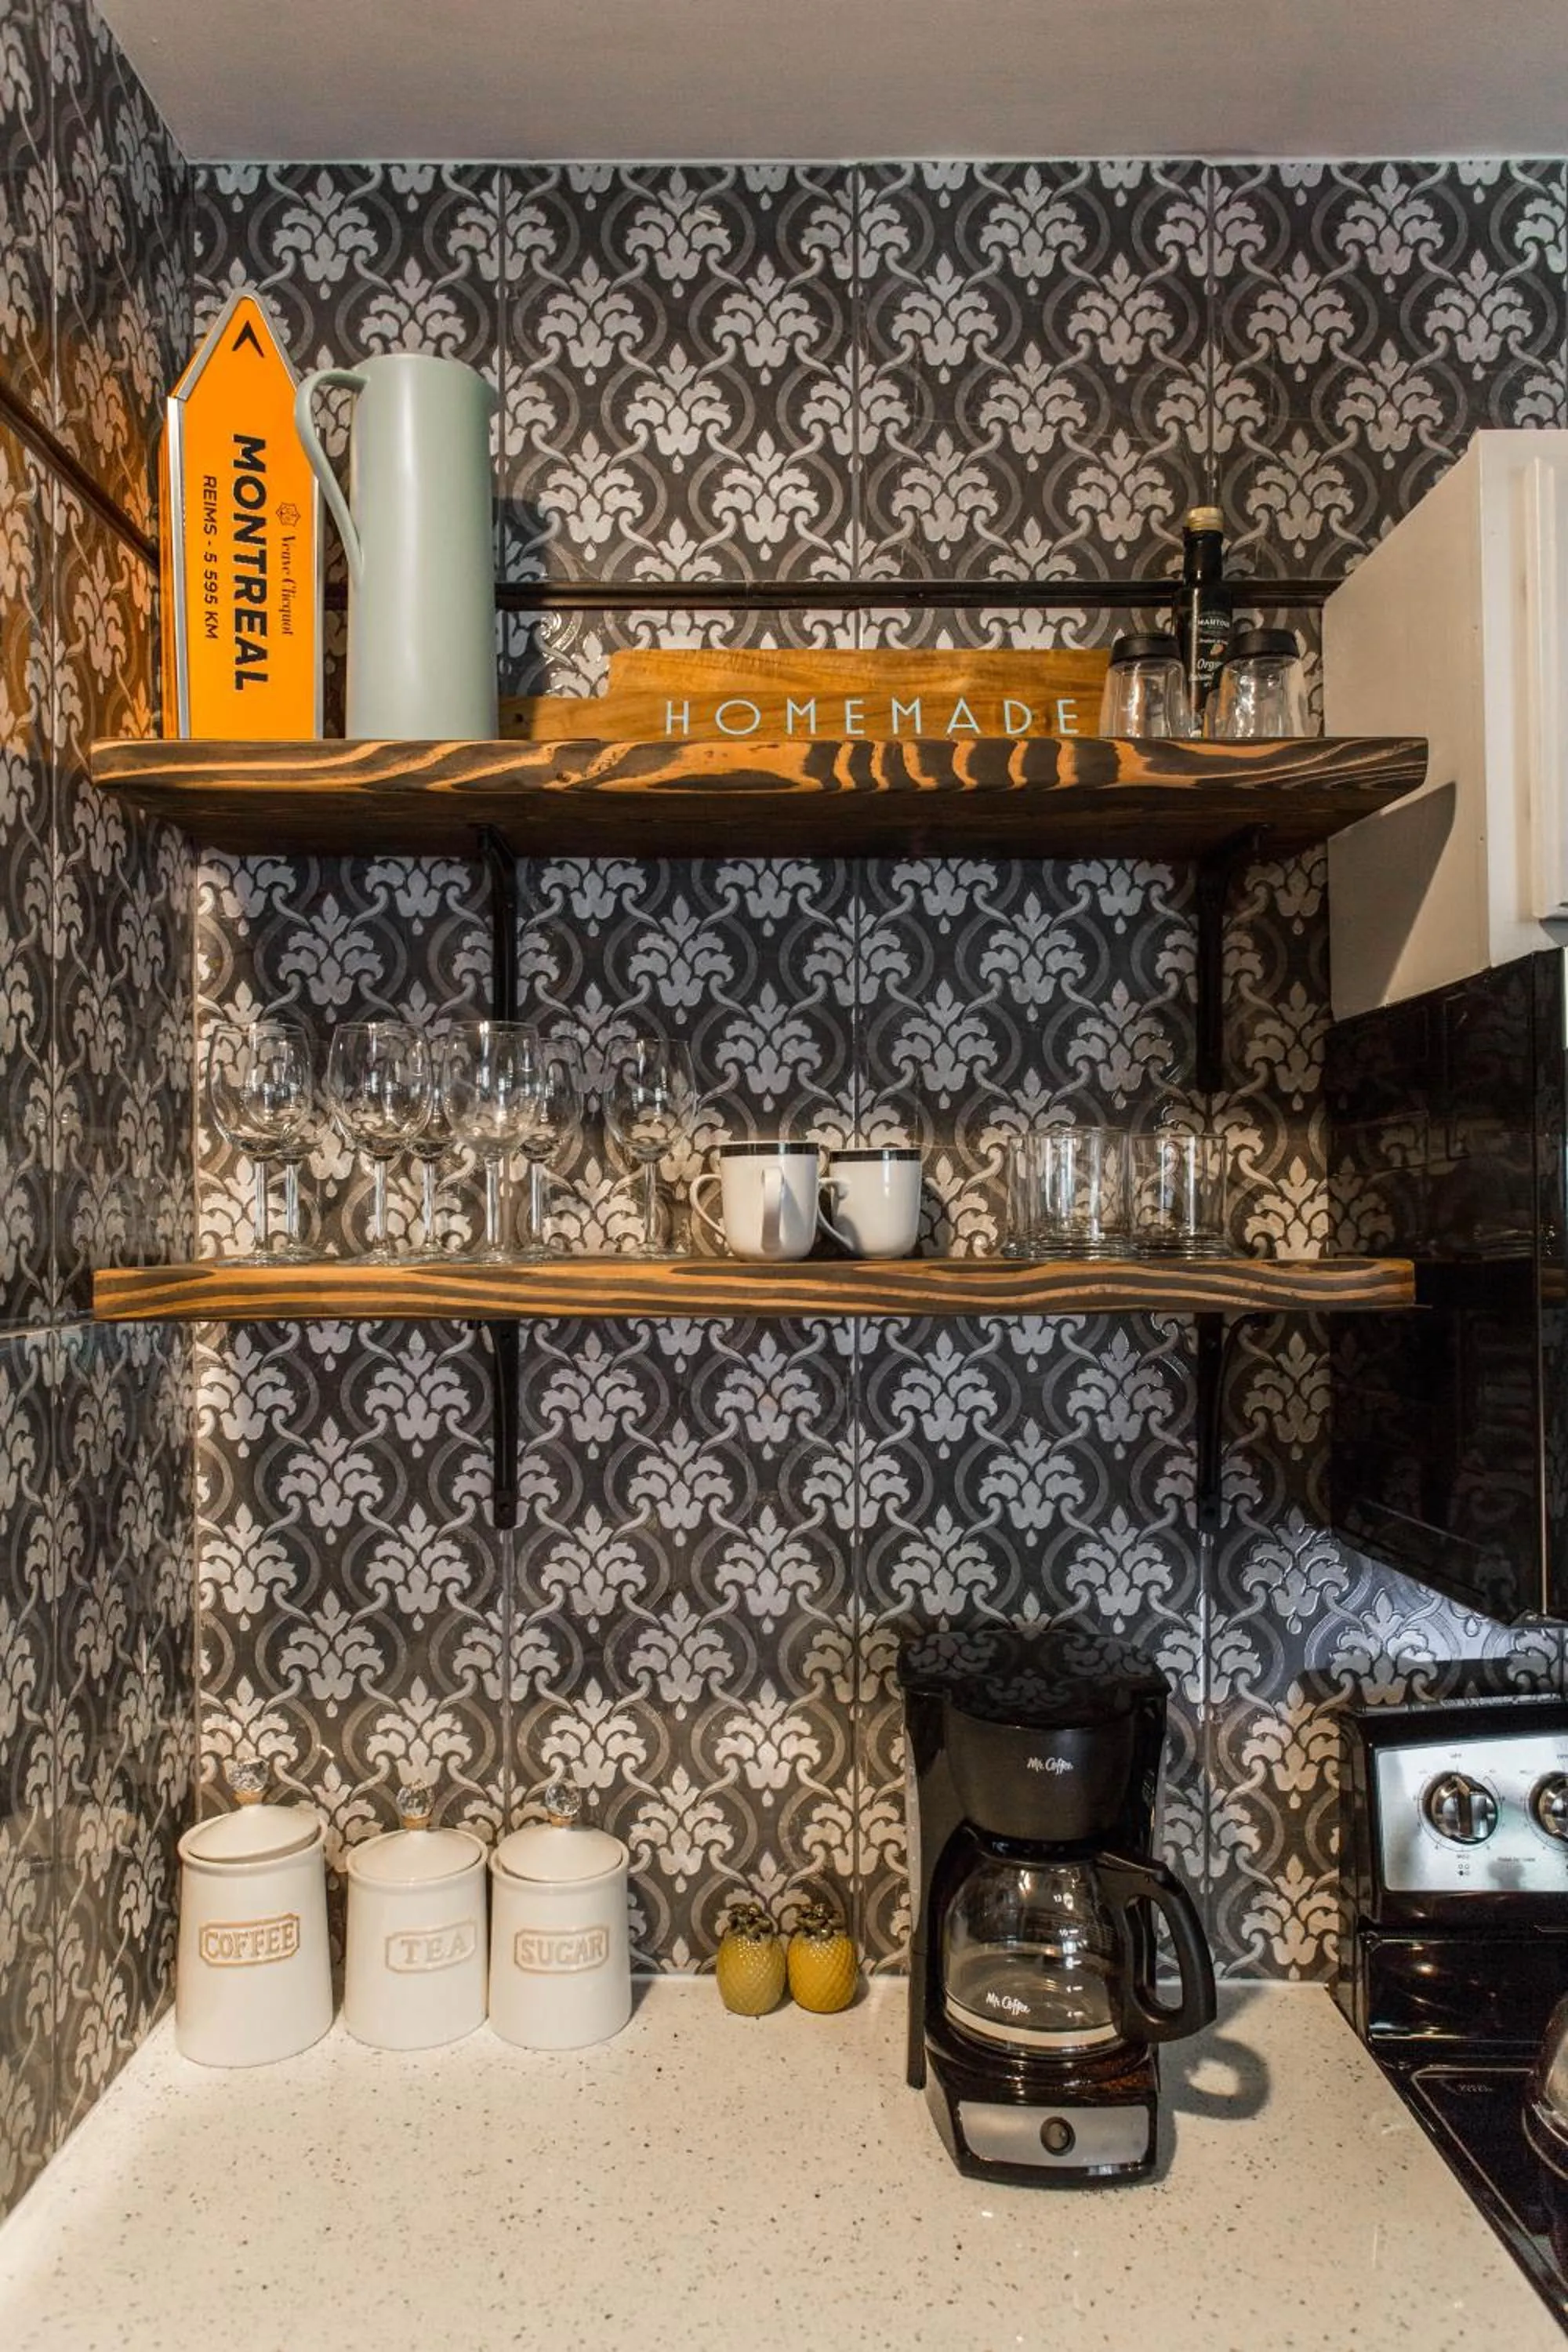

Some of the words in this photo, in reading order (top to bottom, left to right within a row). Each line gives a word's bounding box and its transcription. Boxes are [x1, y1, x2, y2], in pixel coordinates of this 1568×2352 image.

[203, 475, 217, 535] REIMS
[203, 551, 217, 563] 5
[233, 434, 269, 691] MONTREAL
[280, 535, 296, 575] Veuve
[204, 568, 219, 604] 595
[205, 611, 219, 639] KM
[278, 578, 297, 636] Clicquot
[666, 696, 1080, 735] HOMEMADE
[204, 1922, 295, 1958] COFFEE
[400, 1933, 469, 1964] TEA
[521, 1933, 605, 1965] SUGAR
[1001, 1995, 1031, 2016] Coffee
